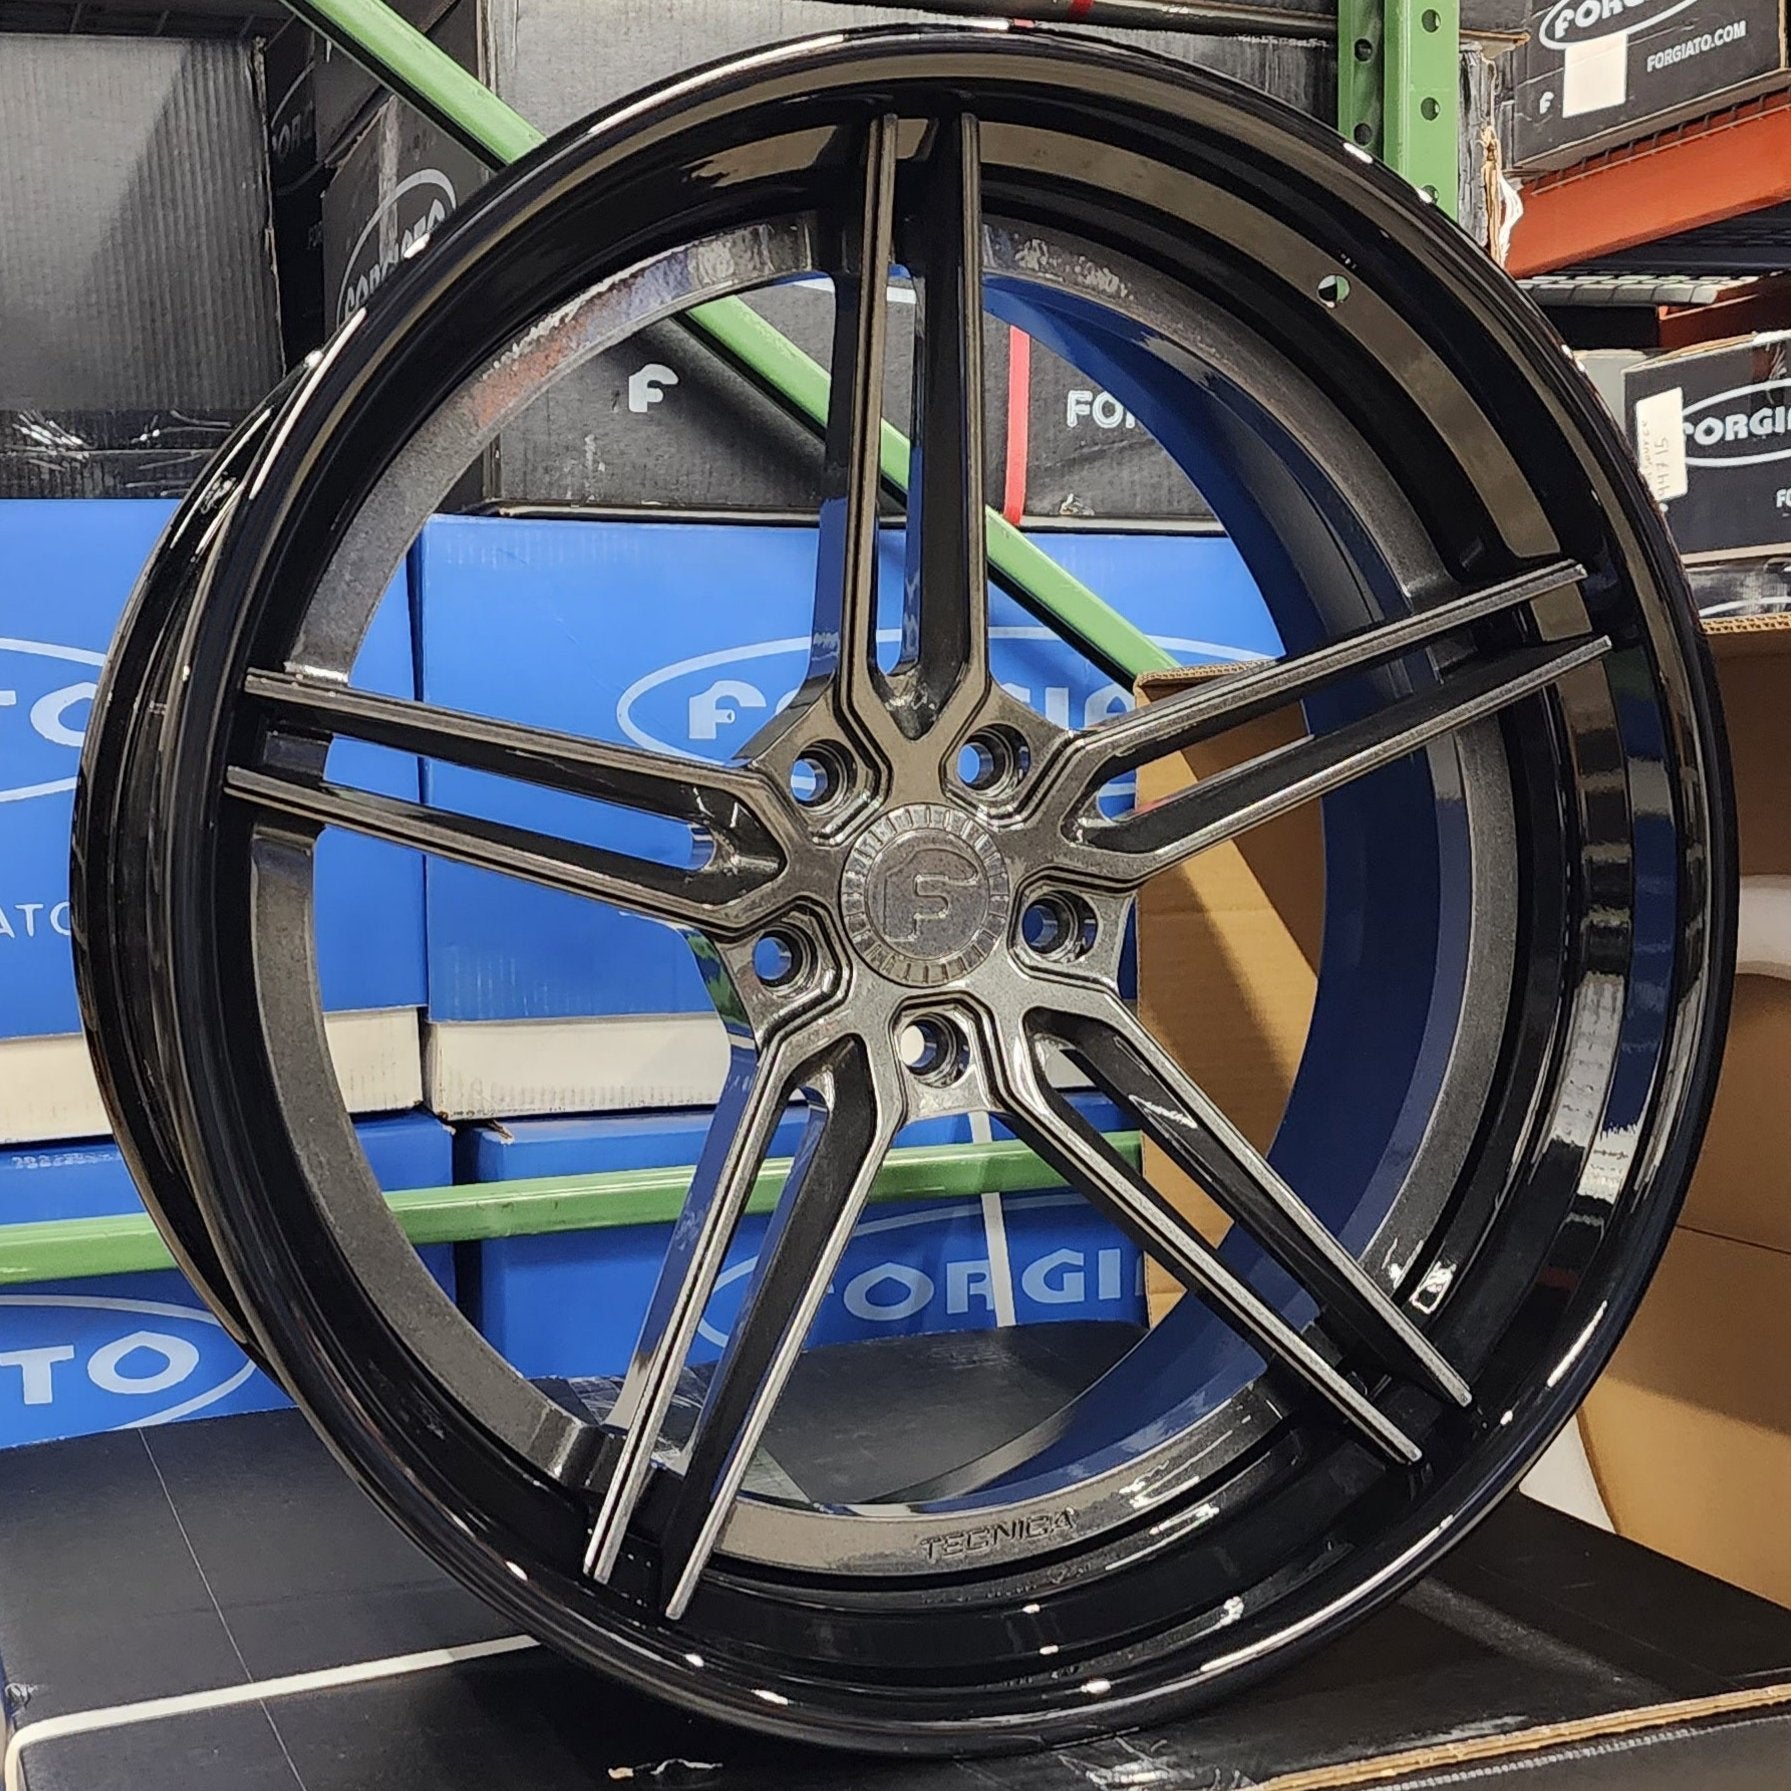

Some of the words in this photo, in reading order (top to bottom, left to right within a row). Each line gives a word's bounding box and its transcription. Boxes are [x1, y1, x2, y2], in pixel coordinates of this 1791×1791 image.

[1647, 20, 1747, 72] FORGIATO.COM
[1540, 91, 1555, 114] F
[628, 363, 679, 413] F
[1683, 405, 1791, 446] ORGI
[0, 1331, 200, 1405] TO
[921, 1507, 1078, 1564] TECNICA
